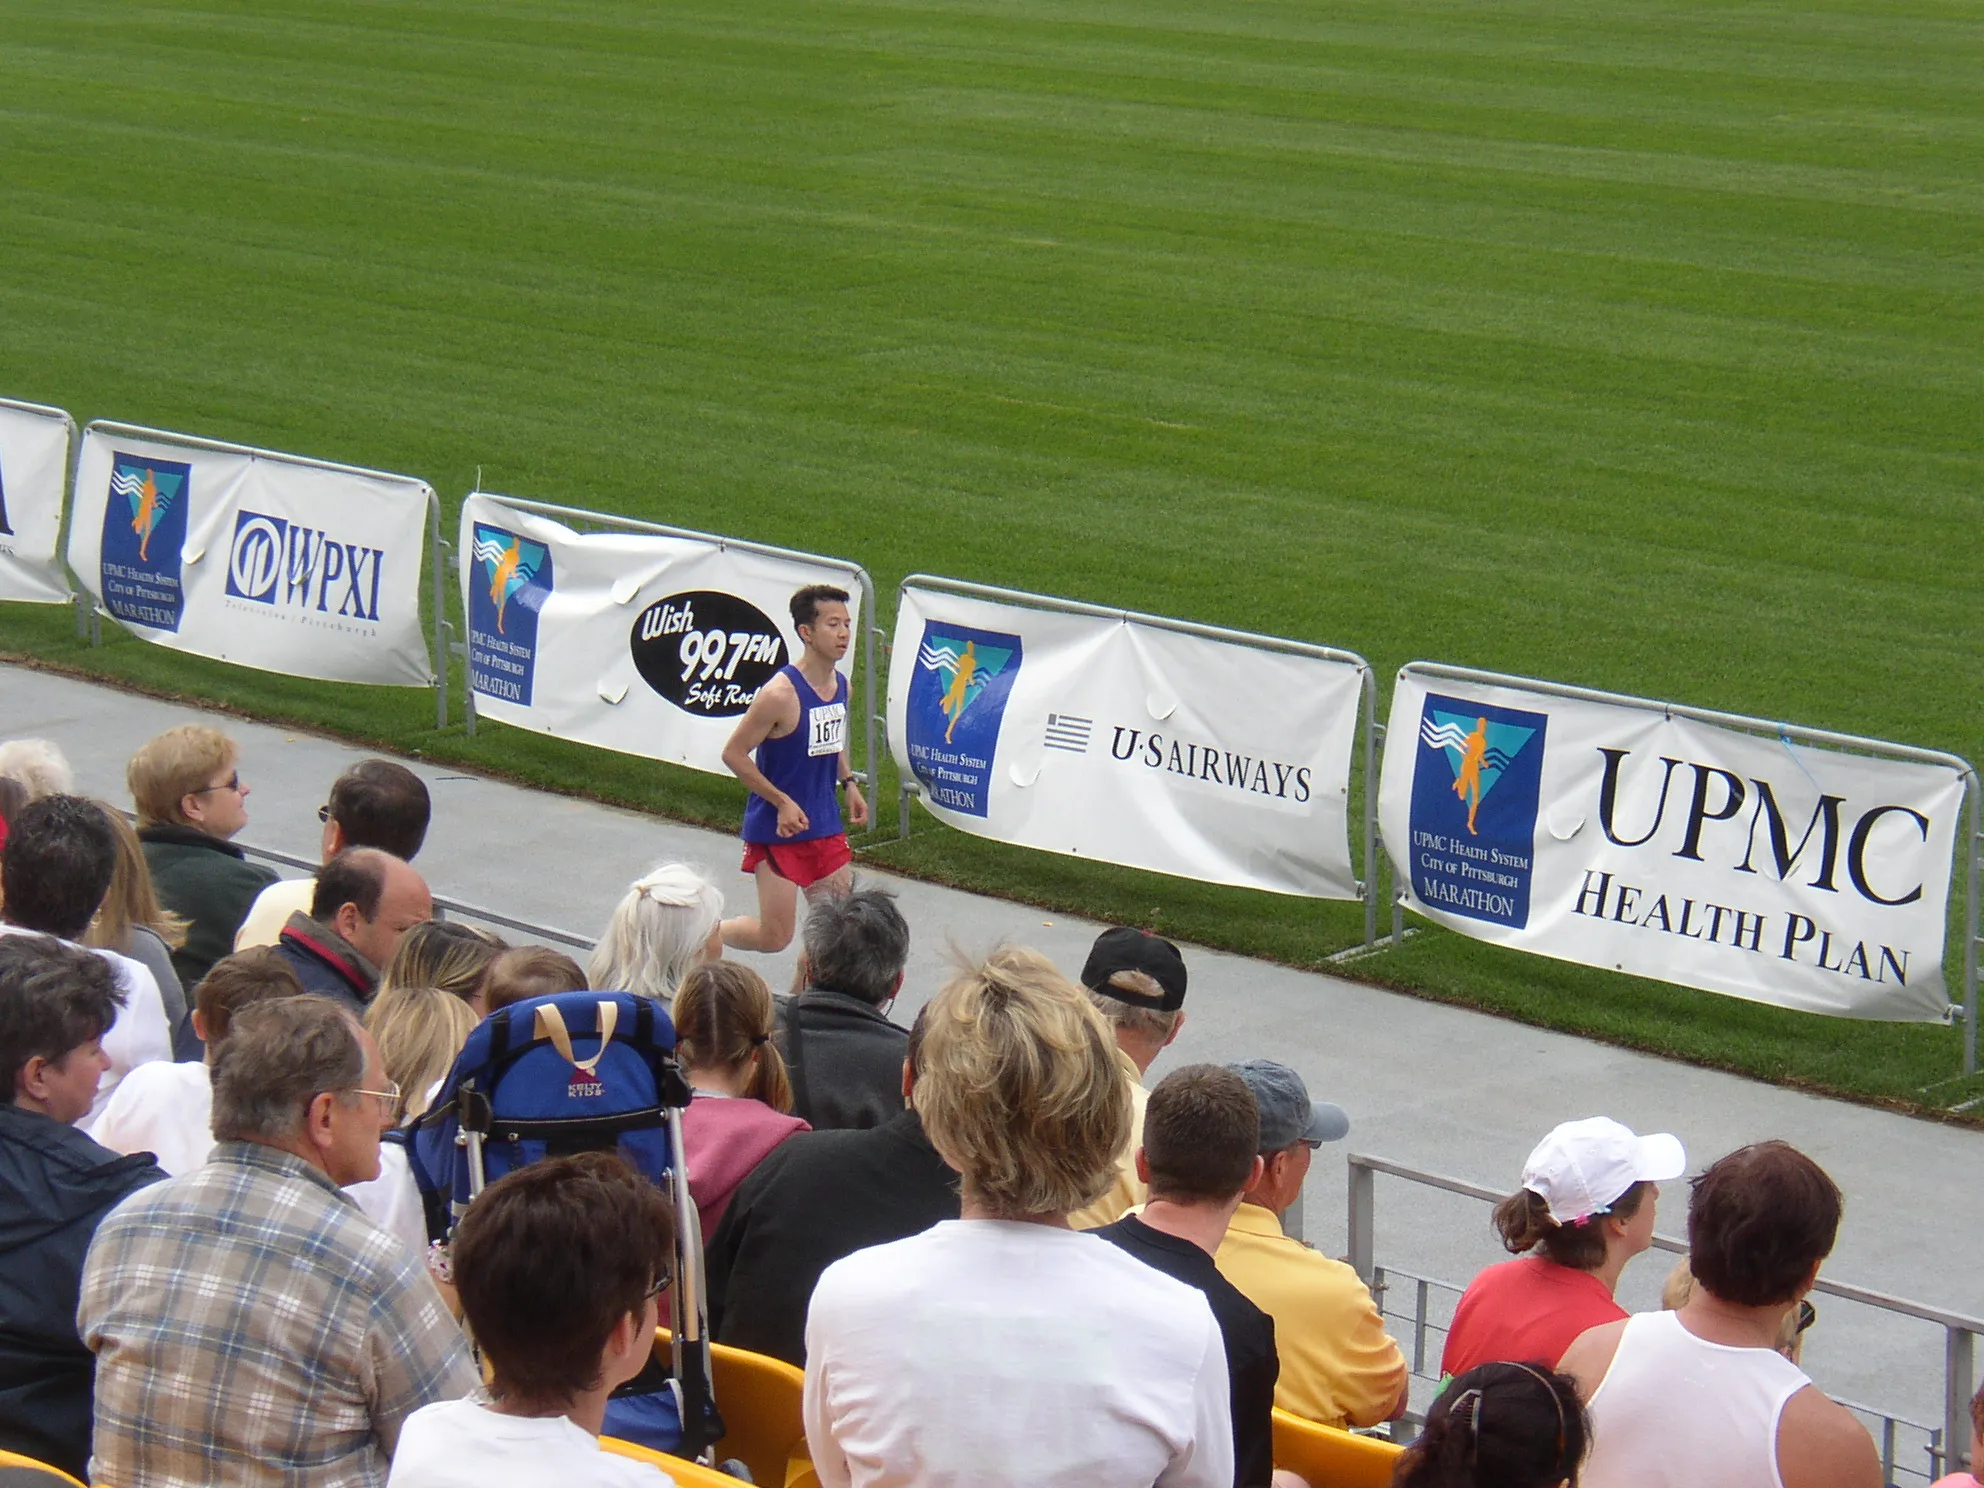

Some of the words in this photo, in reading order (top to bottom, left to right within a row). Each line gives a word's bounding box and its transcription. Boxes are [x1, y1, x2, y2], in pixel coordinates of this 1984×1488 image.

[108, 580, 124, 595] CITY
[287, 525, 384, 621] WPXI
[112, 599, 175, 625] MARATHON
[641, 600, 694, 641] Wish
[471, 629, 487, 646] PMC
[471, 669, 521, 700] MARATHON
[684, 682, 722, 710] Soft
[816, 719, 841, 743] 1677
[930, 748, 958, 765] HEALTH
[959, 753, 987, 769] SYSTEM
[1595, 747, 1930, 907] UPMC
[1413, 830, 1447, 851] UPMC
[1449, 838, 1488, 861] HEALTH
[1491, 847, 1528, 870] SYSTEM
[1421, 852, 1444, 871] CITY
[1445, 862, 1458, 875] OF
[1461, 861, 1518, 888] PITTSBURGH
[1423, 876, 1514, 917] MARATHON
[1570, 869, 1768, 953] HEALTH
[1777, 911, 1912, 987] PLAN
